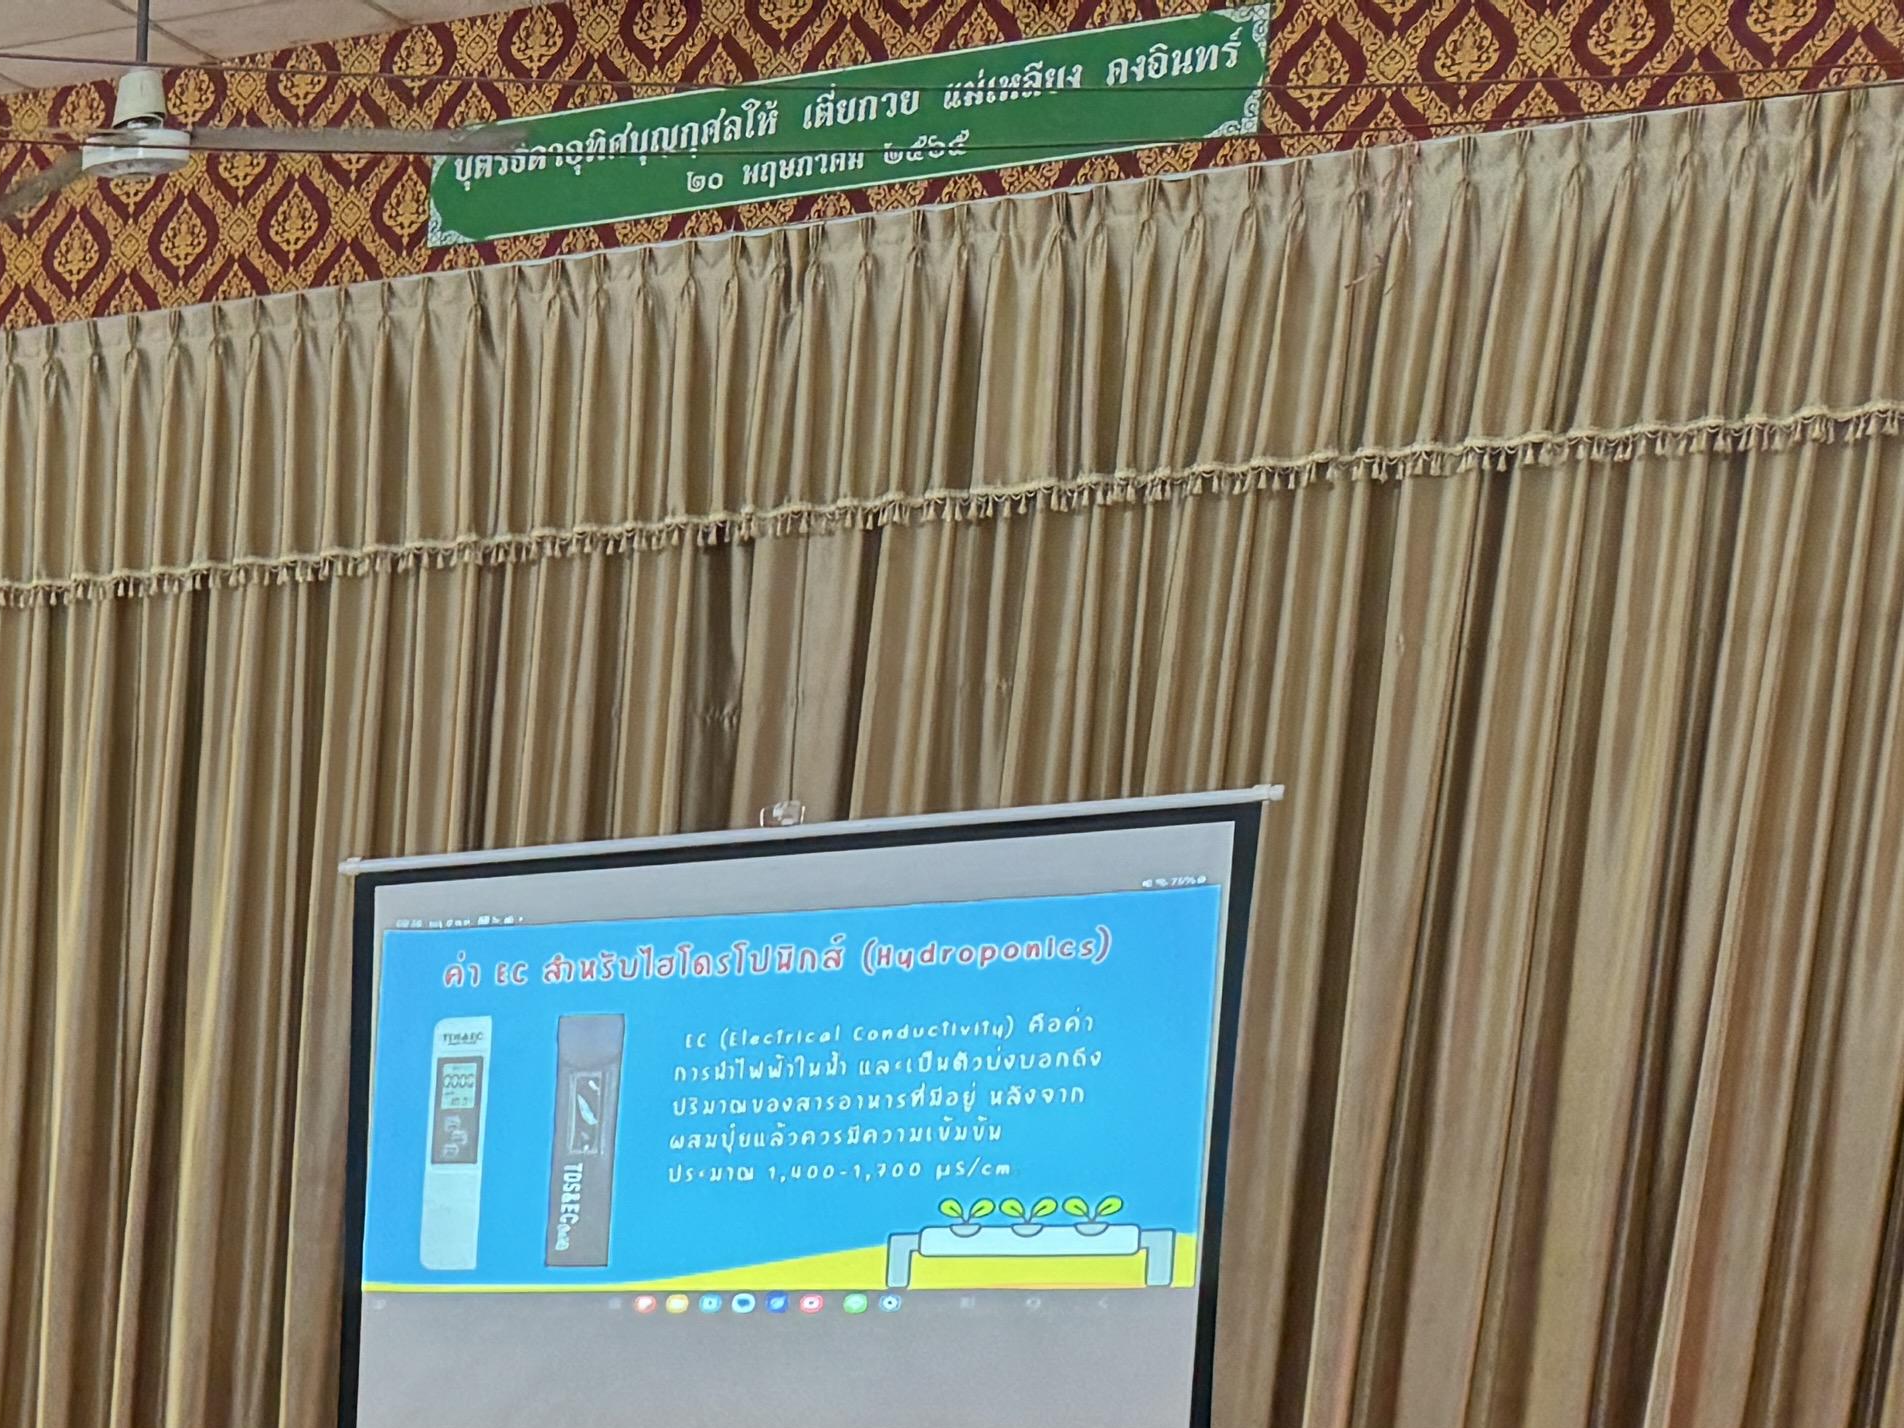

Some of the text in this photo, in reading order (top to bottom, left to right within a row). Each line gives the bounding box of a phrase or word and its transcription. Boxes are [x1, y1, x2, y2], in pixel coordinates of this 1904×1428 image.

[1106, 27, 1242, 86] คงอินทร์
[686, 171, 723, 193] ๒๐
[443, 950, 480, 988] ค่า
[495, 961, 528, 985] EC
[542, 933, 847, 985] สำหรับไฮโดรโปนิกส์
[685, 1033, 707, 1048] EC
[668, 1163, 754, 1183] ประมาณ
